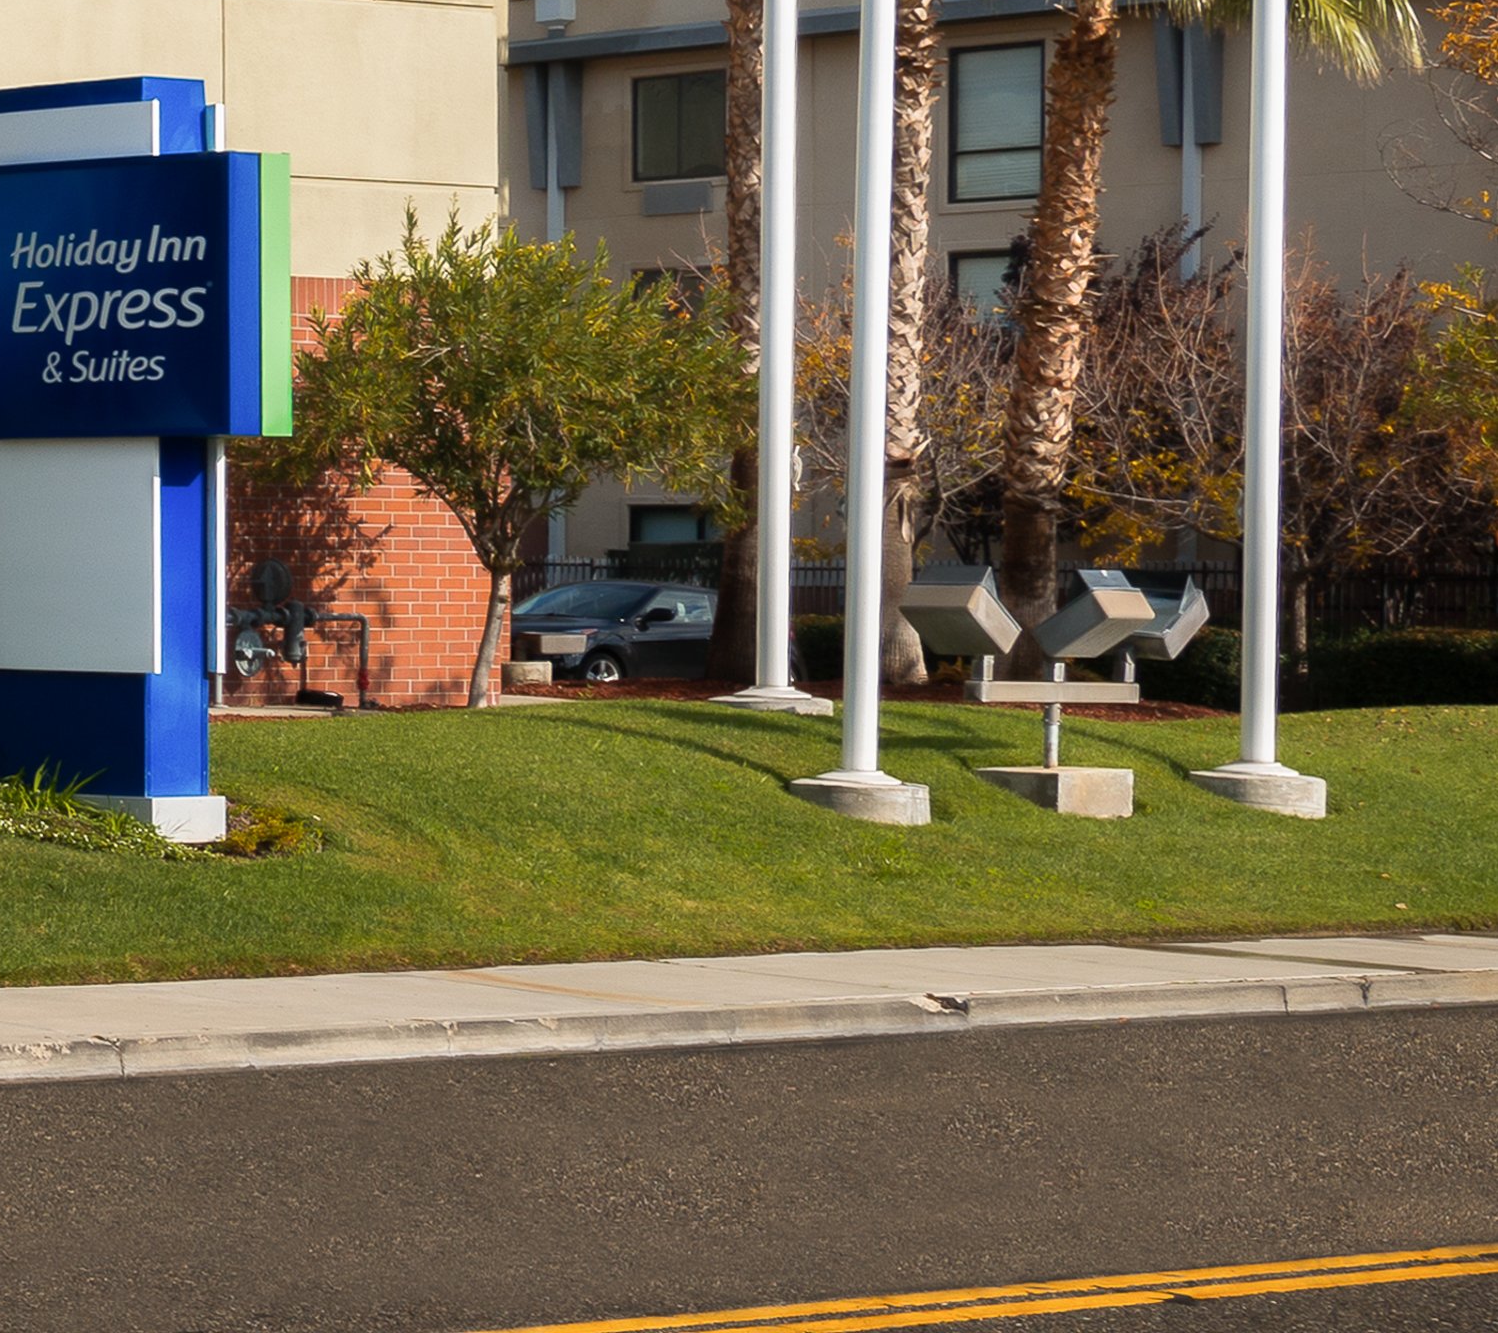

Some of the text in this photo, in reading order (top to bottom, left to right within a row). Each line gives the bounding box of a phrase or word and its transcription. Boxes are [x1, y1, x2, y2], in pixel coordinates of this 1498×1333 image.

[10, 224, 207, 274] Holiday Inn
[11, 281, 207, 346] Express
[41, 349, 166, 384] & Suites
